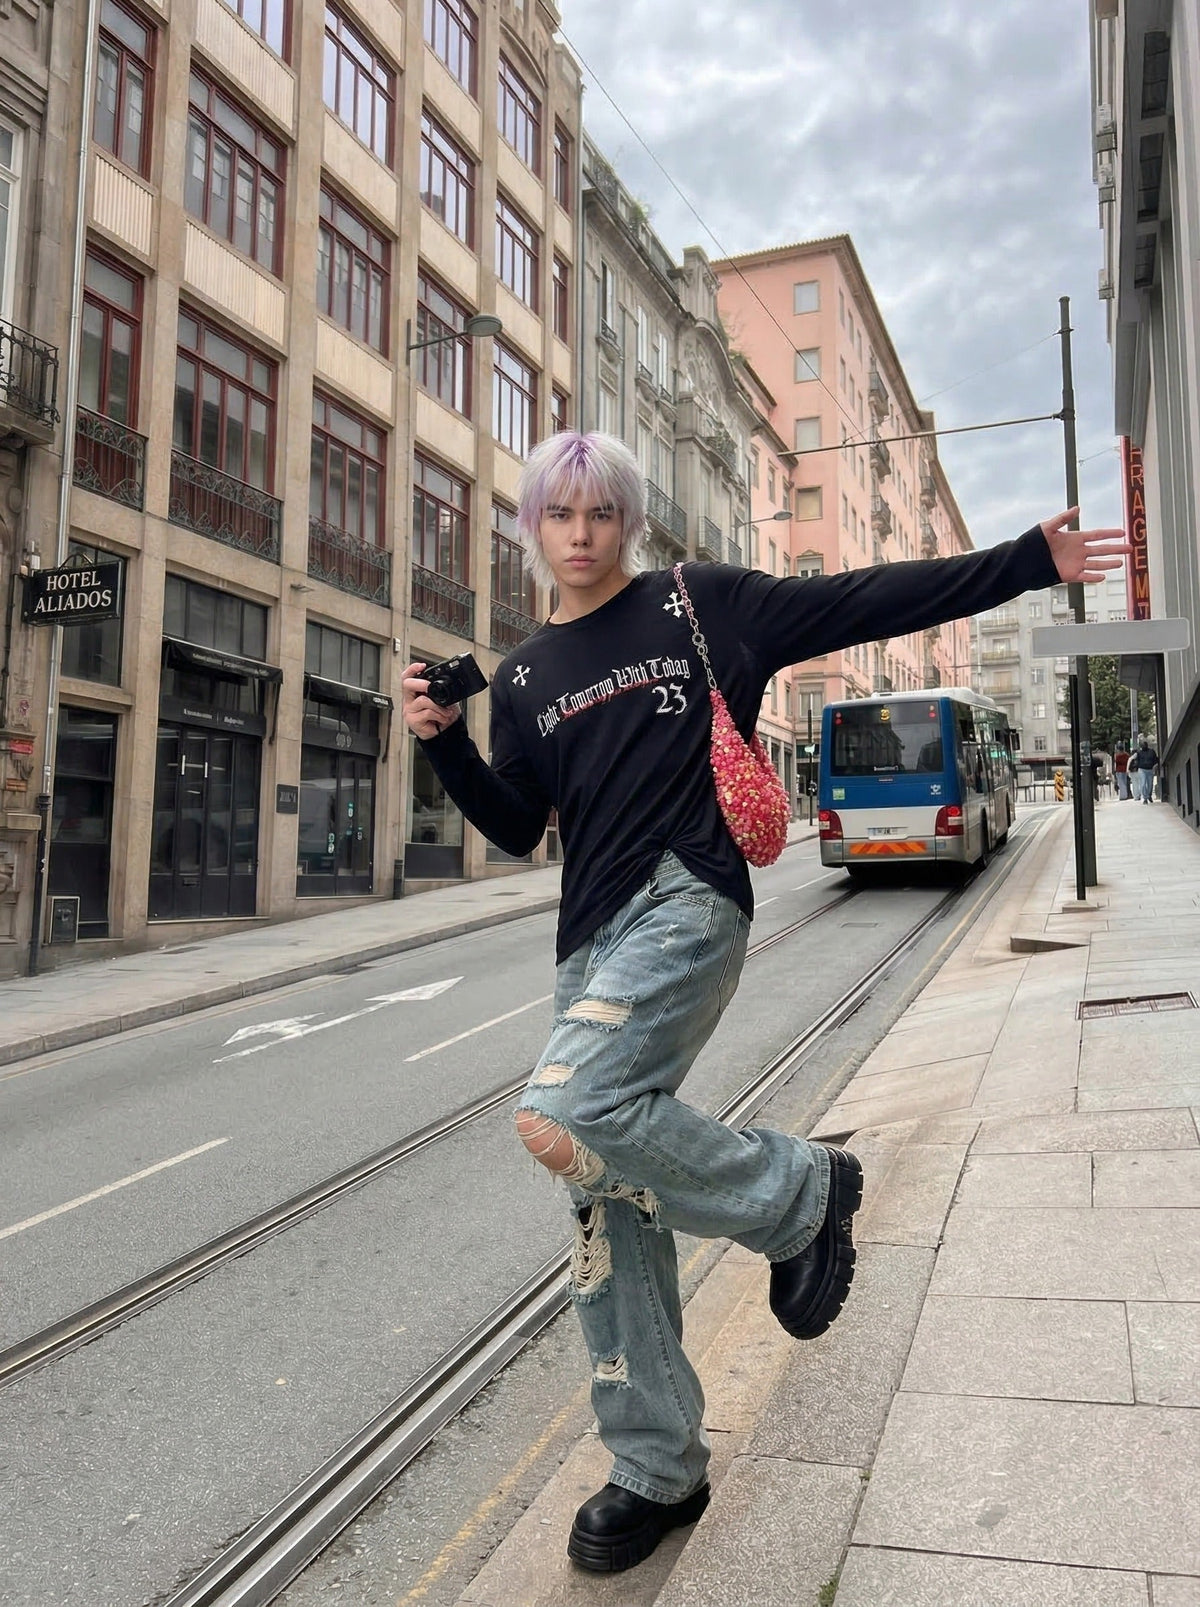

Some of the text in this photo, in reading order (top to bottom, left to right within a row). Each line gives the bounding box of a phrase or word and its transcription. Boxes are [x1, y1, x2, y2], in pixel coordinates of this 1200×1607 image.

[46, 571, 101, 591] HOTEL
[34, 589, 112, 614] ALIADOS
[611, 662, 650, 688] With
[645, 656, 691, 679] Today
[651, 682, 688, 716] 23
